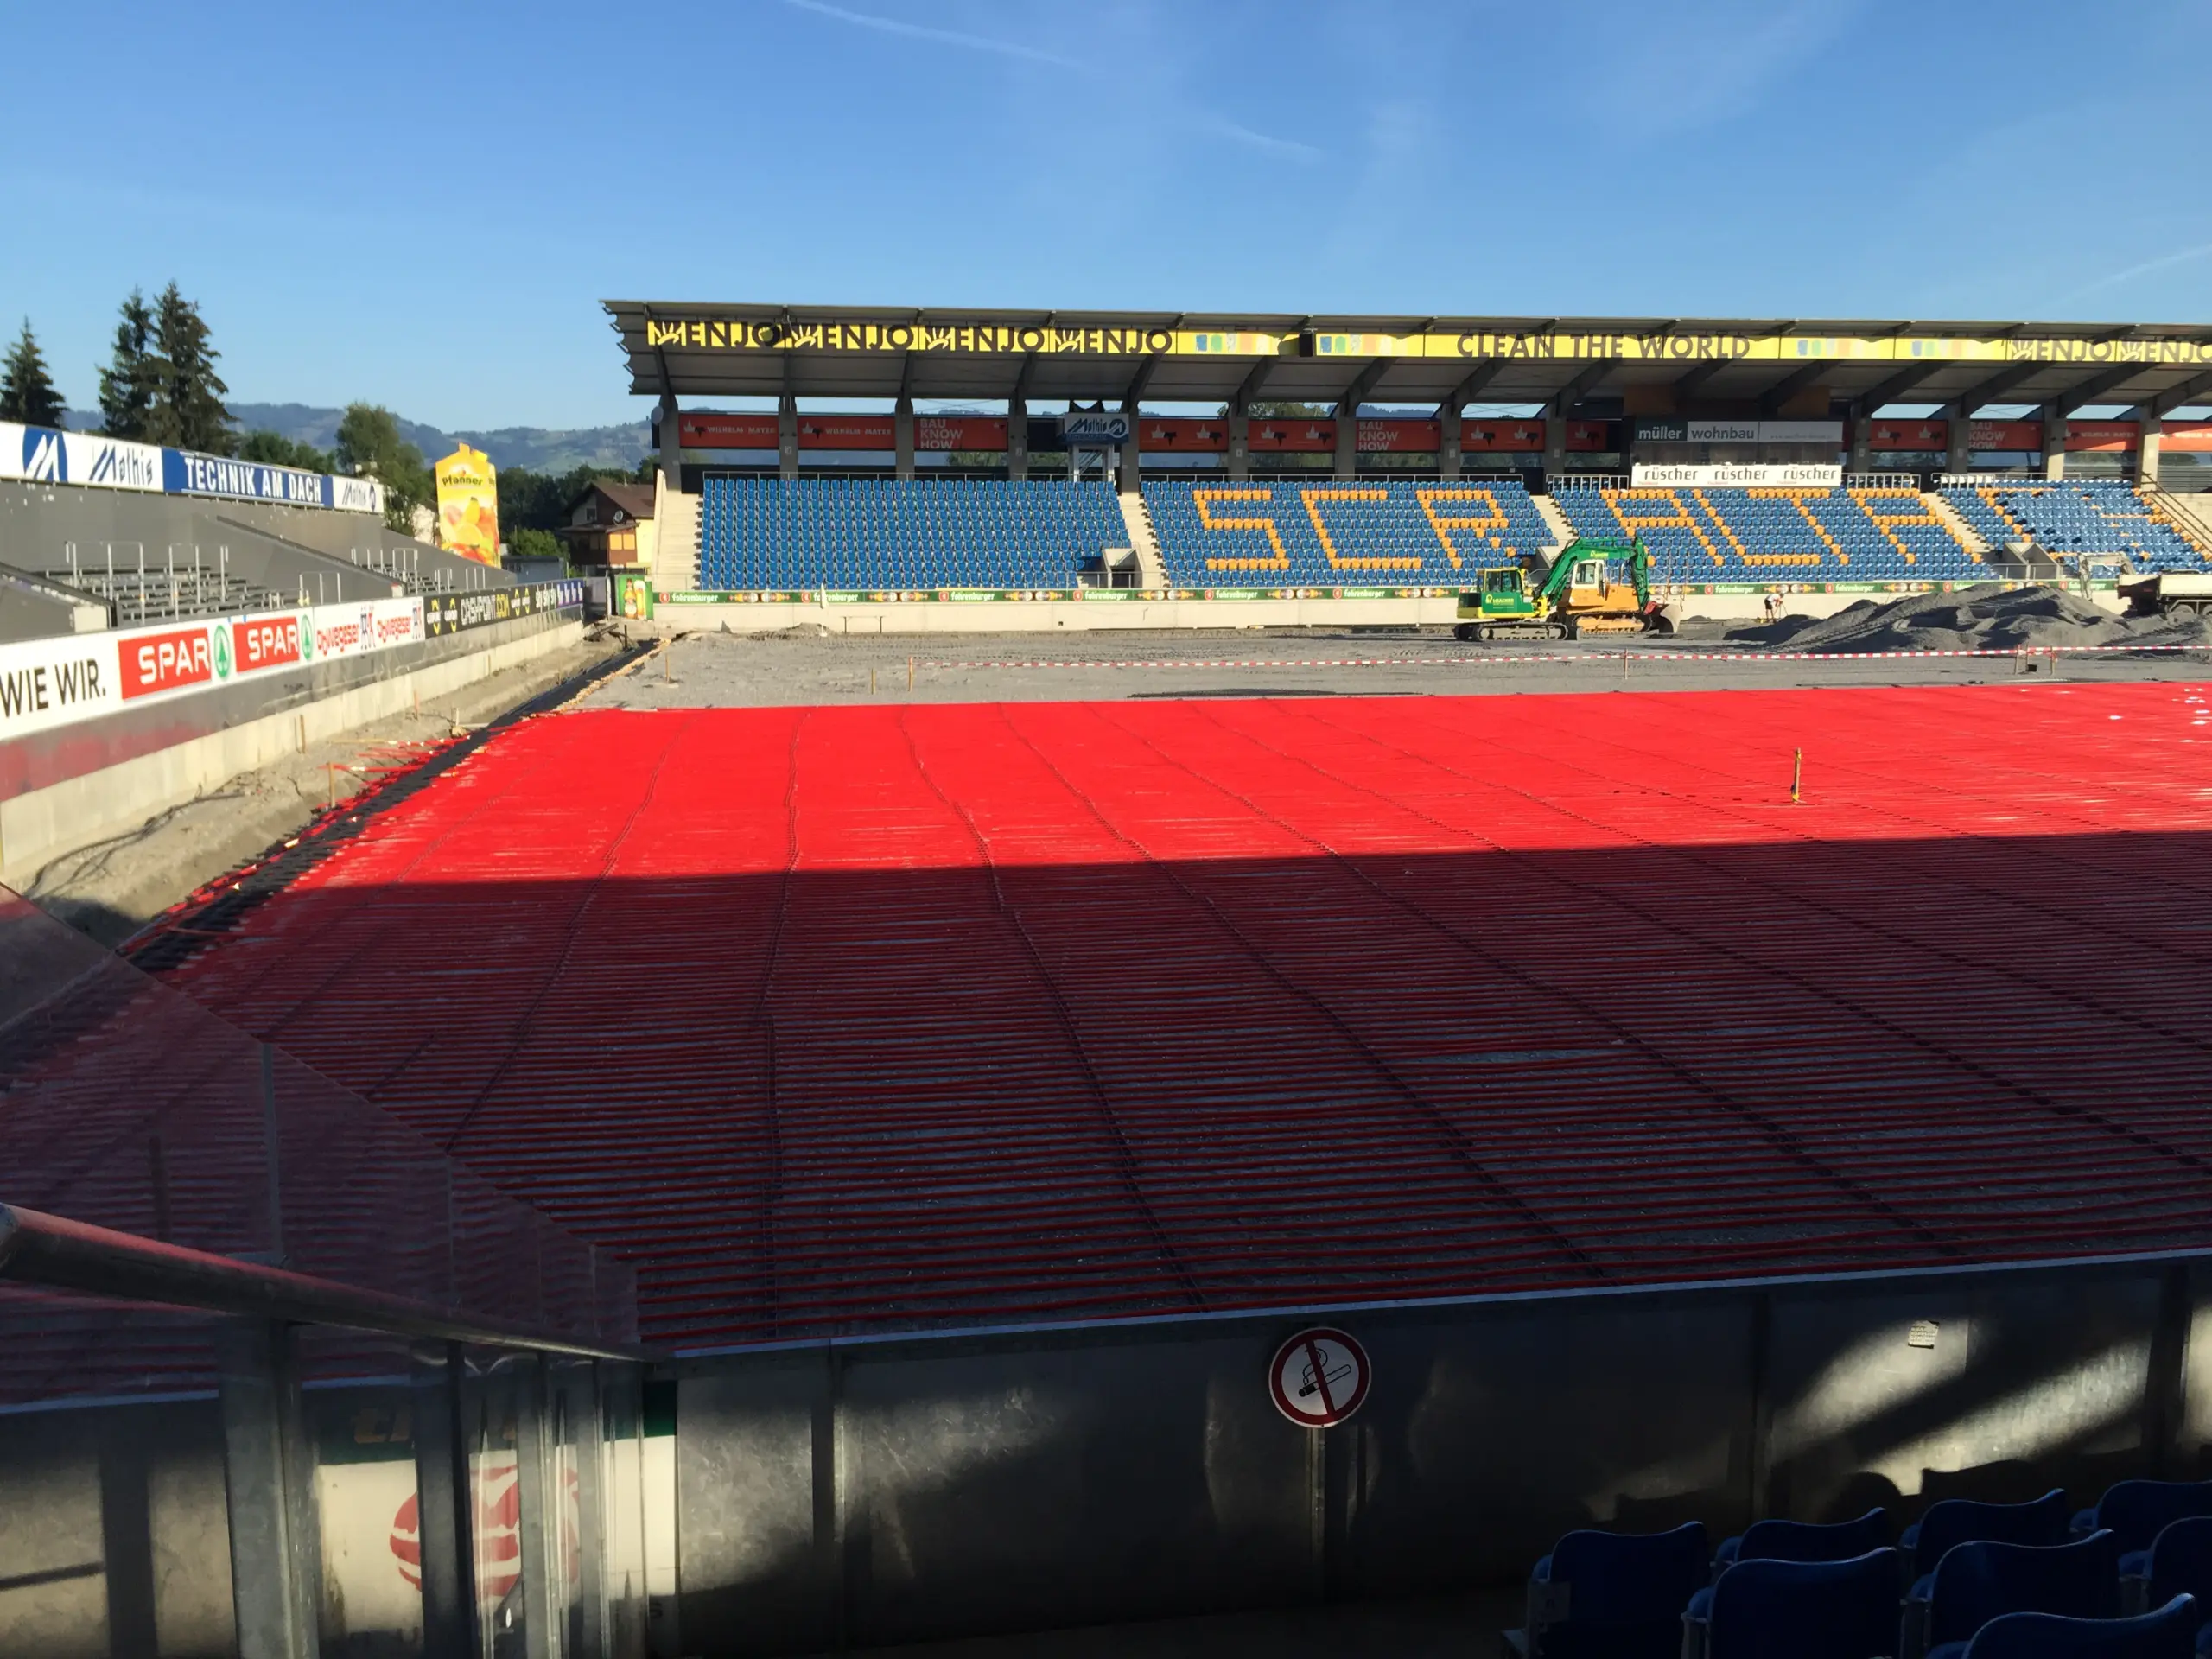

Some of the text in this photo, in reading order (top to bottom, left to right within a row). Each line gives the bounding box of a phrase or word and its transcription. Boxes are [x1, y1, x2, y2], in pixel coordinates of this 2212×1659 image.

[1456, 333, 1750, 359] CLEAN THE WORLD
[919, 418, 947, 429] BAU
[1358, 421, 1382, 430] BAU
[919, 429, 963, 439] KNOW
[1358, 431, 1398, 442] KNOW
[1638, 426, 1754, 439] müller wohnbau
[919, 440, 954, 449] HOW
[1358, 442, 1389, 451] HOW
[184, 457, 322, 503] TECHNIK AM DACH
[1644, 467, 1698, 480] rüscher
[1714, 467, 1768, 480] rüscher
[1783, 467, 1836, 480] rüscher
[247, 624, 299, 662] SPAR
[138, 637, 210, 685] SPAR
[0, 658, 105, 718] WIE WIR.
